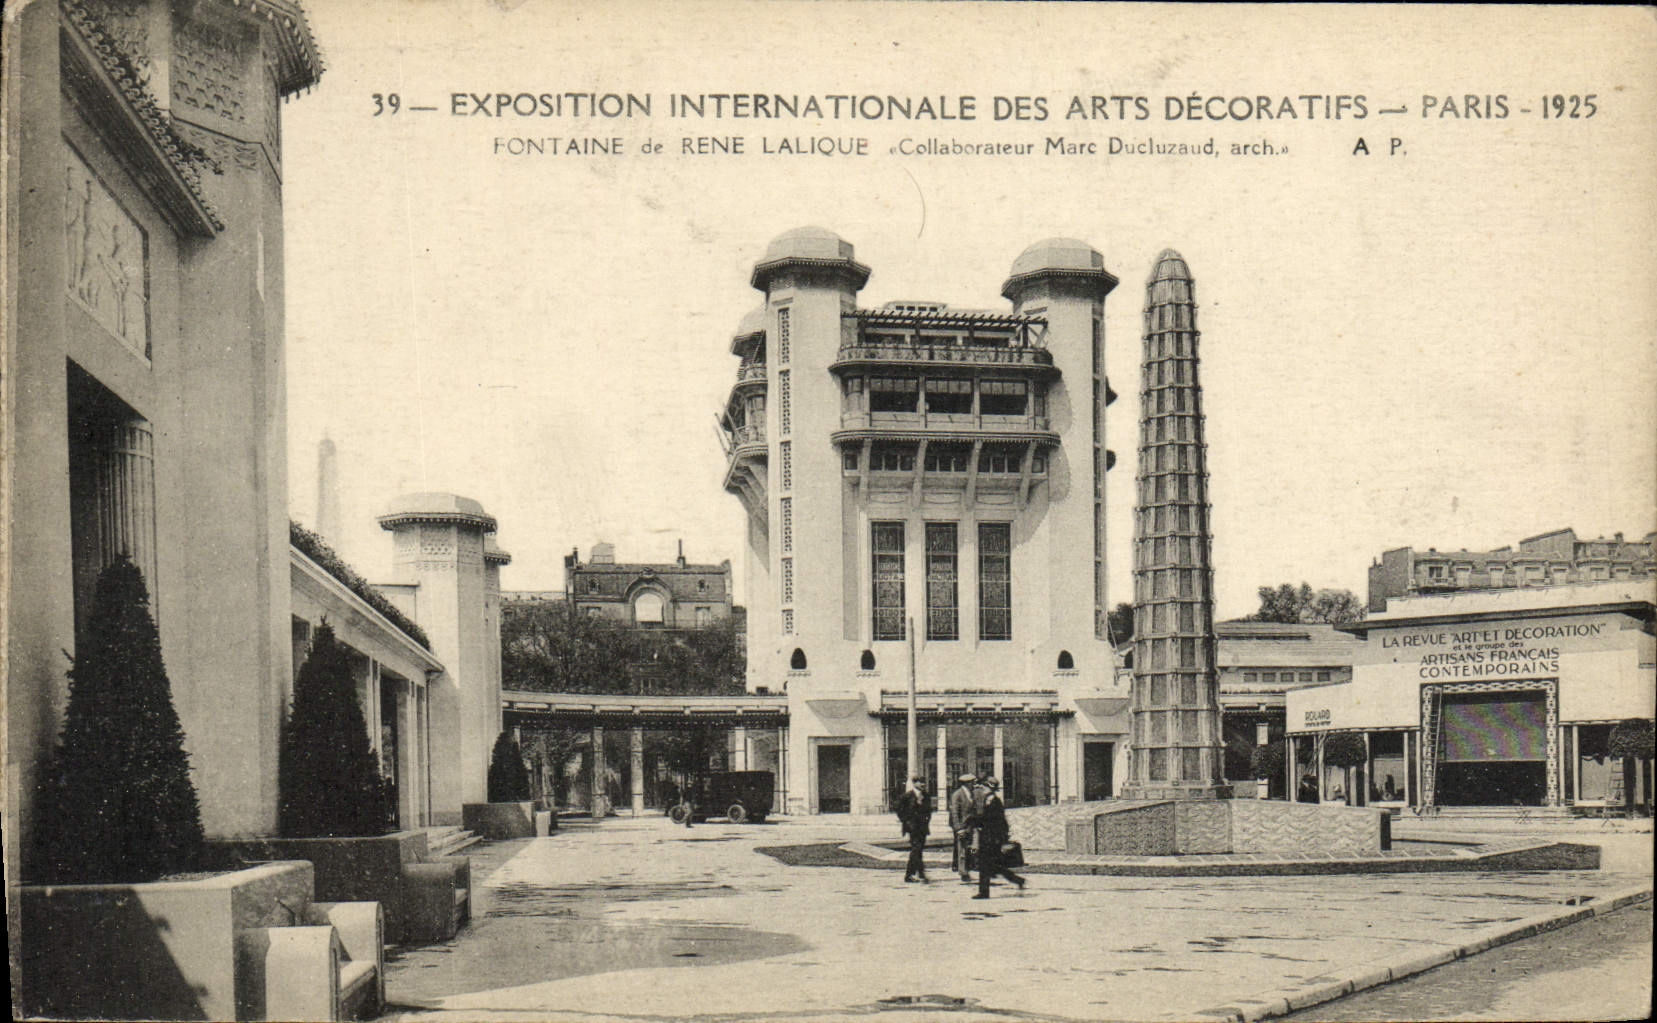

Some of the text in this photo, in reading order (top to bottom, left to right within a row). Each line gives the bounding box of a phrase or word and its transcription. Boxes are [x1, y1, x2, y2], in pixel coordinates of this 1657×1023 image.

[1382, 637, 1400, 649] LA
[1403, 632, 1447, 647] REVUE
[1475, 642, 1506, 651] groupe
[1508, 640, 1524, 648] des
[1420, 647, 1560, 666] ARTISANS FRANÇAIS
[1419, 660, 1560, 679] CONTEMPORAINS
